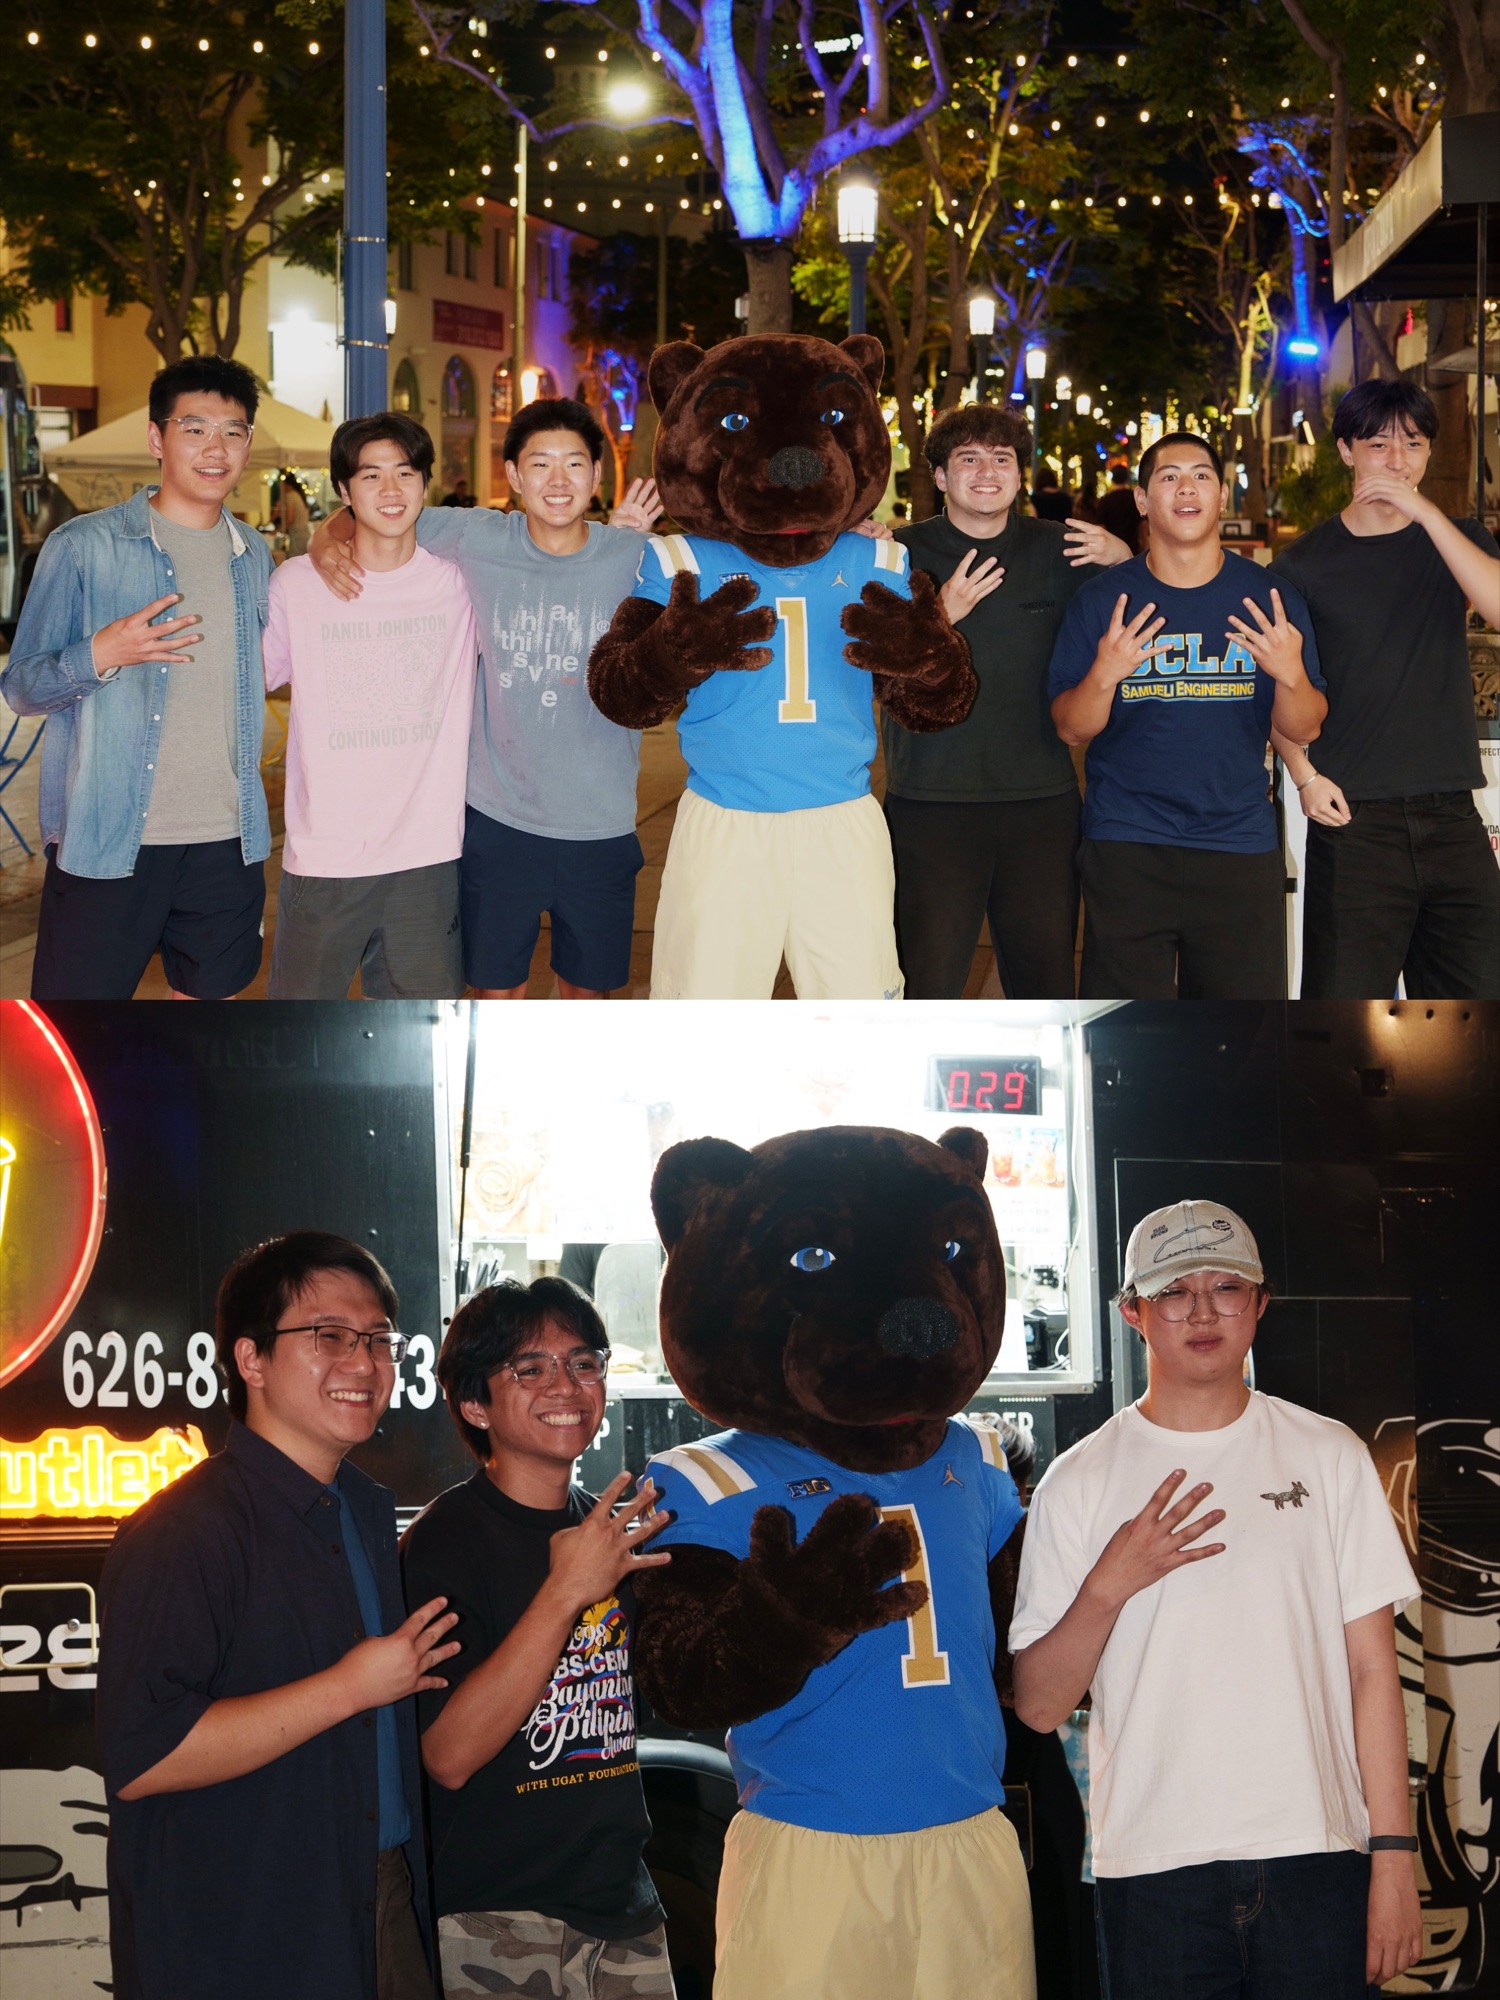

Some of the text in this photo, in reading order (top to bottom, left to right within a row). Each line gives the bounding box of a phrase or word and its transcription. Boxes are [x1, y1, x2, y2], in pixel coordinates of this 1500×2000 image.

[321, 613, 447, 640] DANIEL JOHNSTON
[776, 597, 816, 723] 1
[1176, 681, 1255, 697] ENGINEERING
[328, 727, 407, 750] CONTINUED
[947, 1071, 1025, 1109] 029
[876, 1503, 951, 1689] 1
[554, 1649, 629, 1679] BS-CBN
[516, 1779, 548, 1794] WITH
[552, 1773, 584, 1787] UGAT
